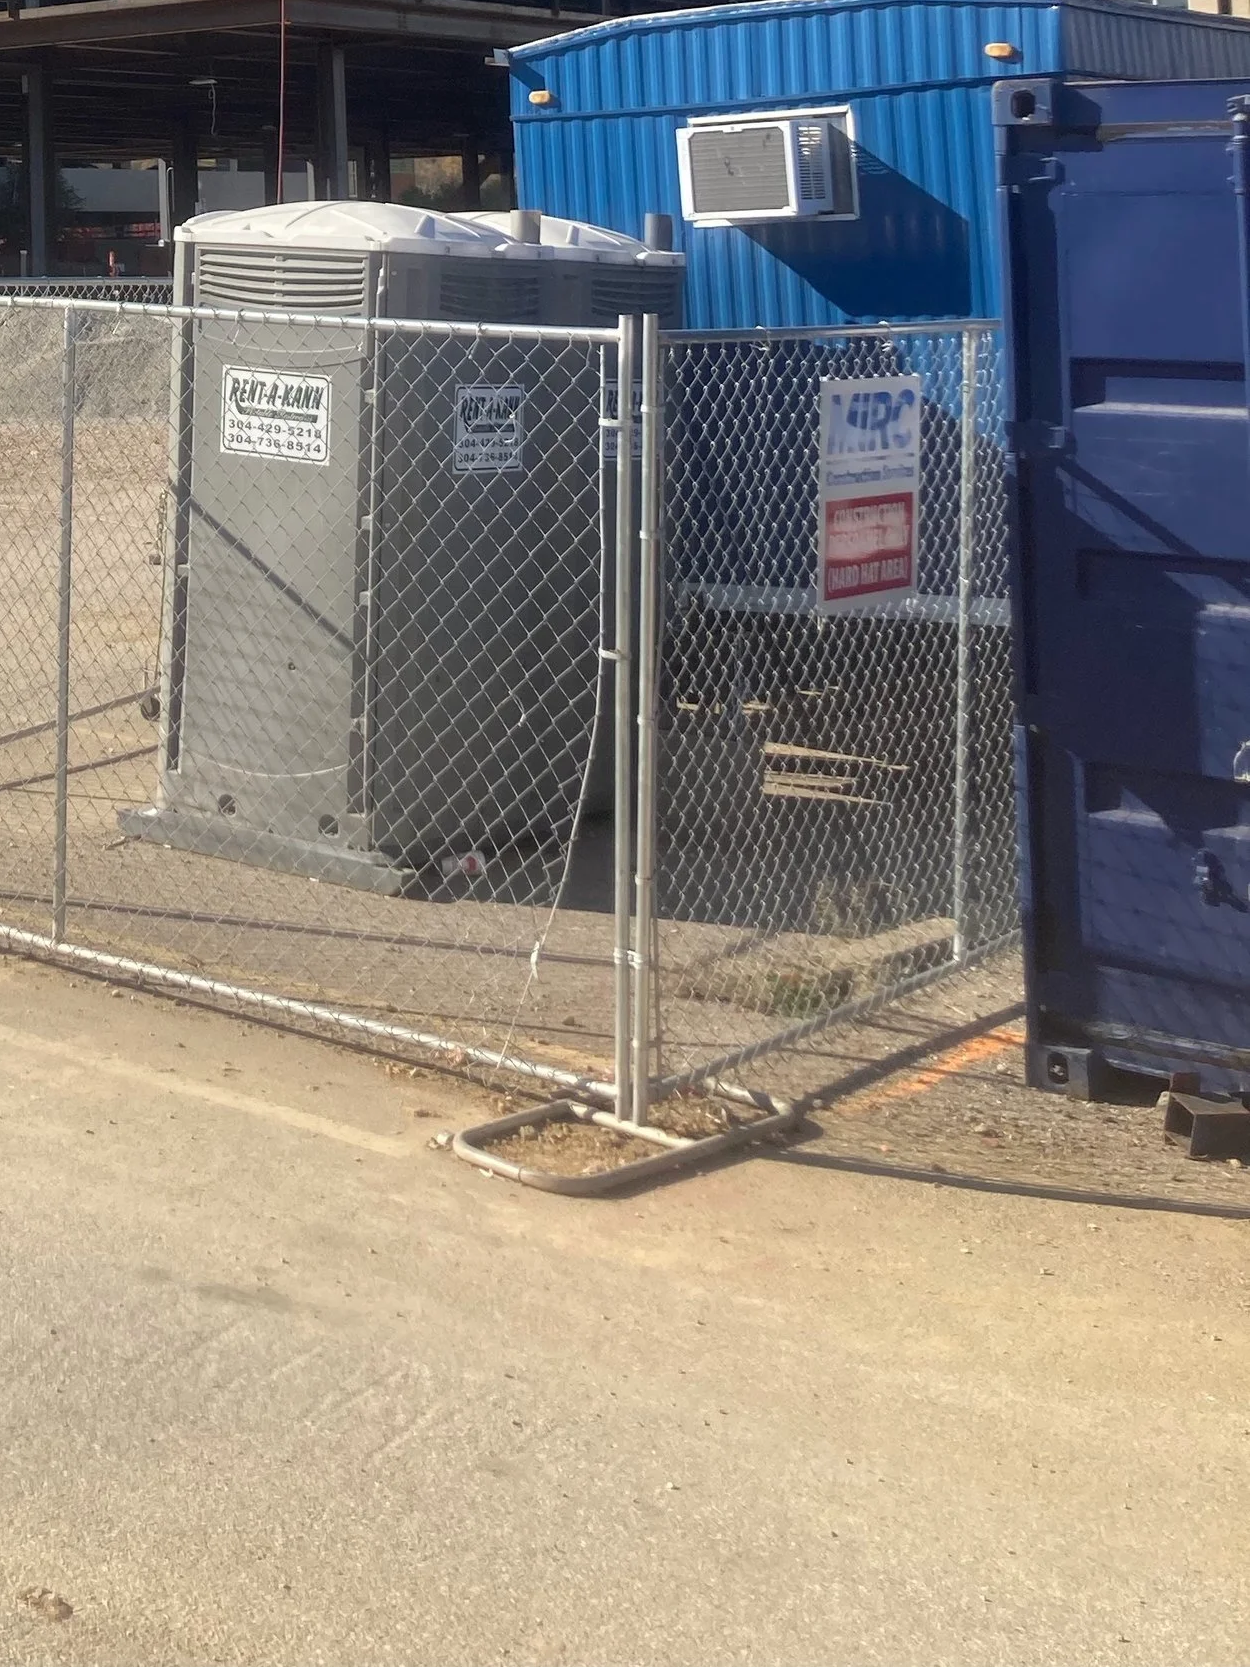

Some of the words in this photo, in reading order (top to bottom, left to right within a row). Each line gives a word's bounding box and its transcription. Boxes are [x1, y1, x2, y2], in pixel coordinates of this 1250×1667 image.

[229, 377, 324, 411] RENT-A-KANN
[228, 419, 322, 439] 304-429-5218
[228, 433, 321, 453] 304-736-8514
